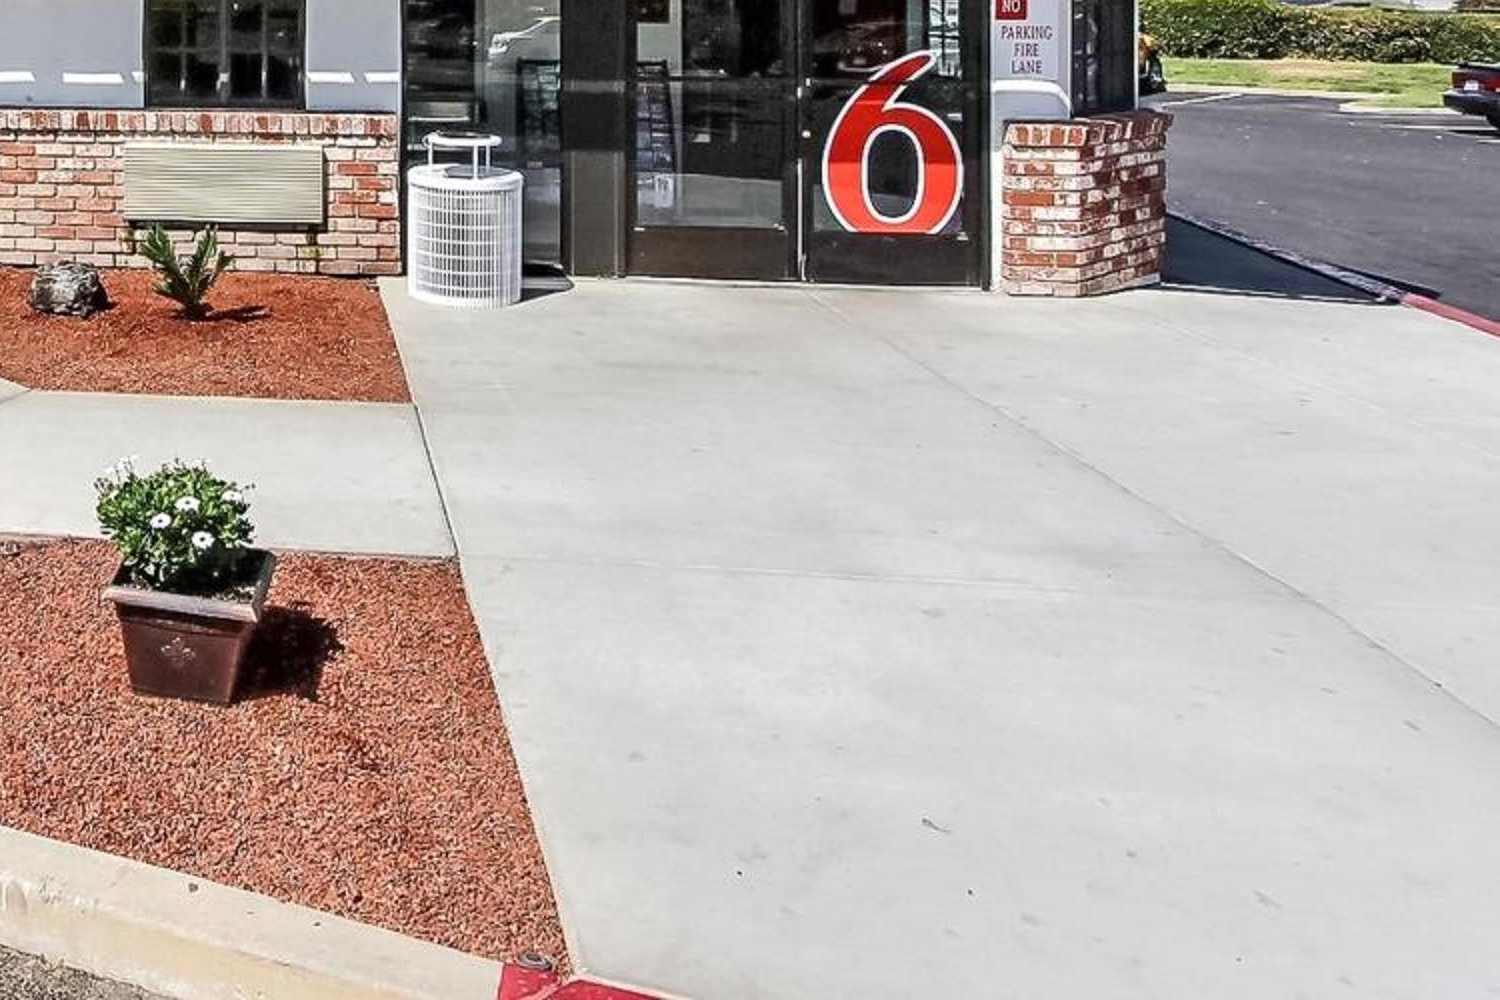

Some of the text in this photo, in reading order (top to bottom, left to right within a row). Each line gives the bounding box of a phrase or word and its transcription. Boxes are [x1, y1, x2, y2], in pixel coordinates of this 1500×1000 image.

[1001, 25, 1053, 41] PARKING
[1013, 43, 1039, 57] FIRE
[1011, 60, 1043, 75] LANE
[823, 49, 963, 234] 6
